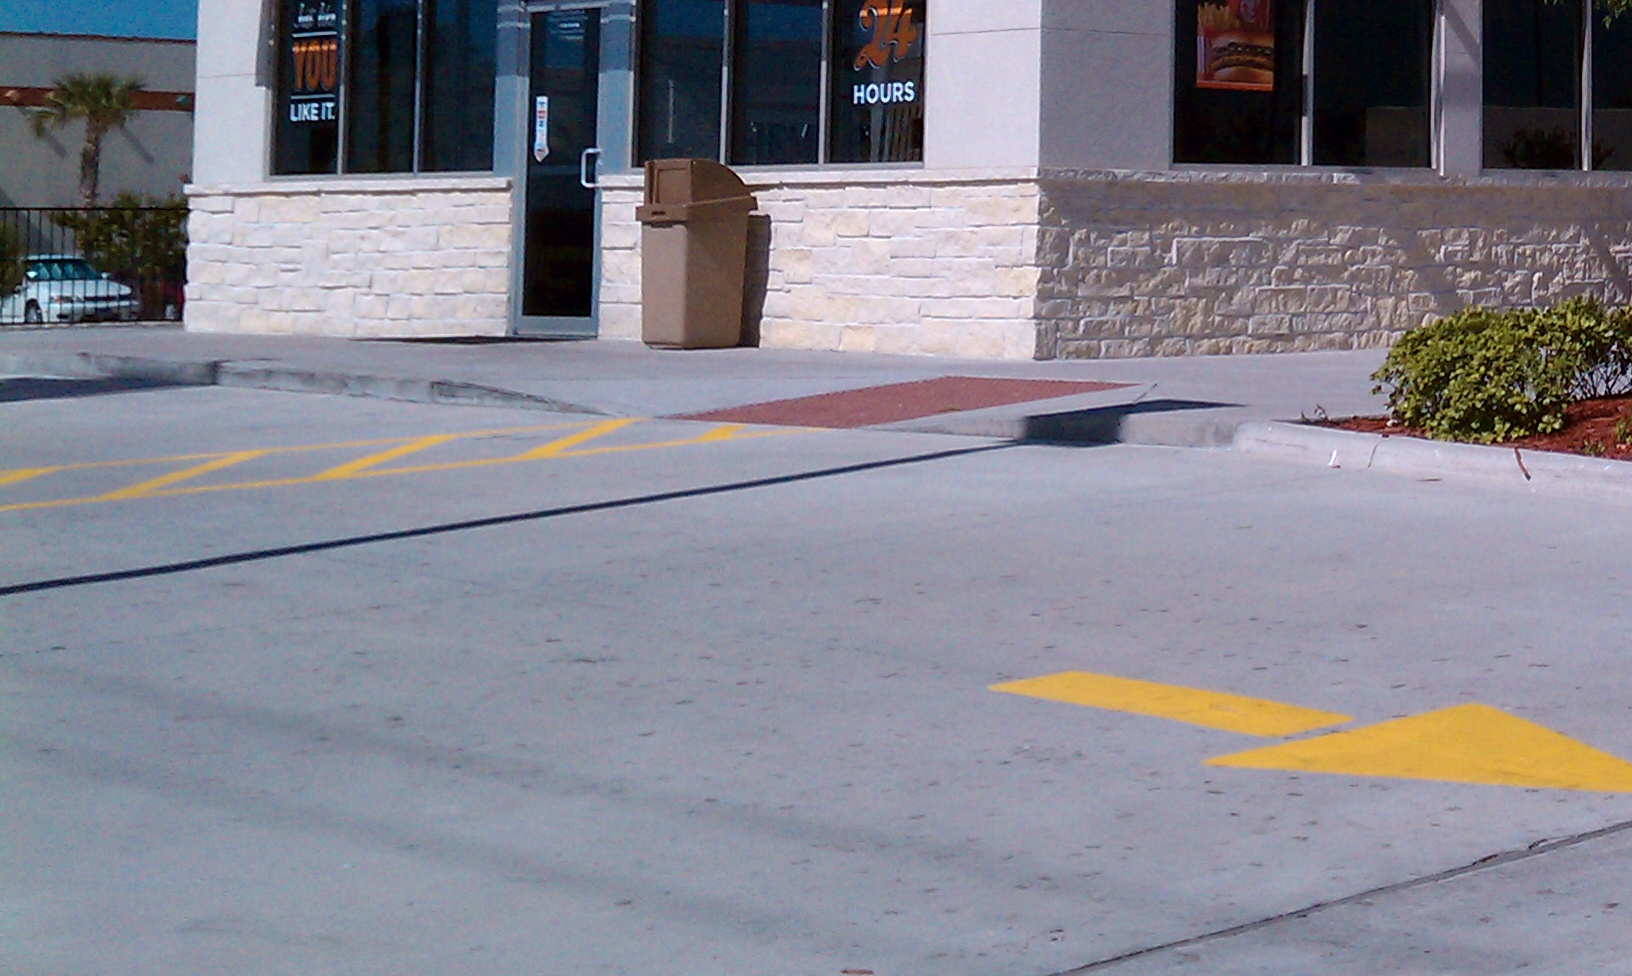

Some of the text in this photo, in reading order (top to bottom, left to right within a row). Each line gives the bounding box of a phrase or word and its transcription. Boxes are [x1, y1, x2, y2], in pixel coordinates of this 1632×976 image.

[292, 39, 337, 91] YOU
[853, 81, 915, 105] HOURS
[290, 103, 319, 122] LIKE
